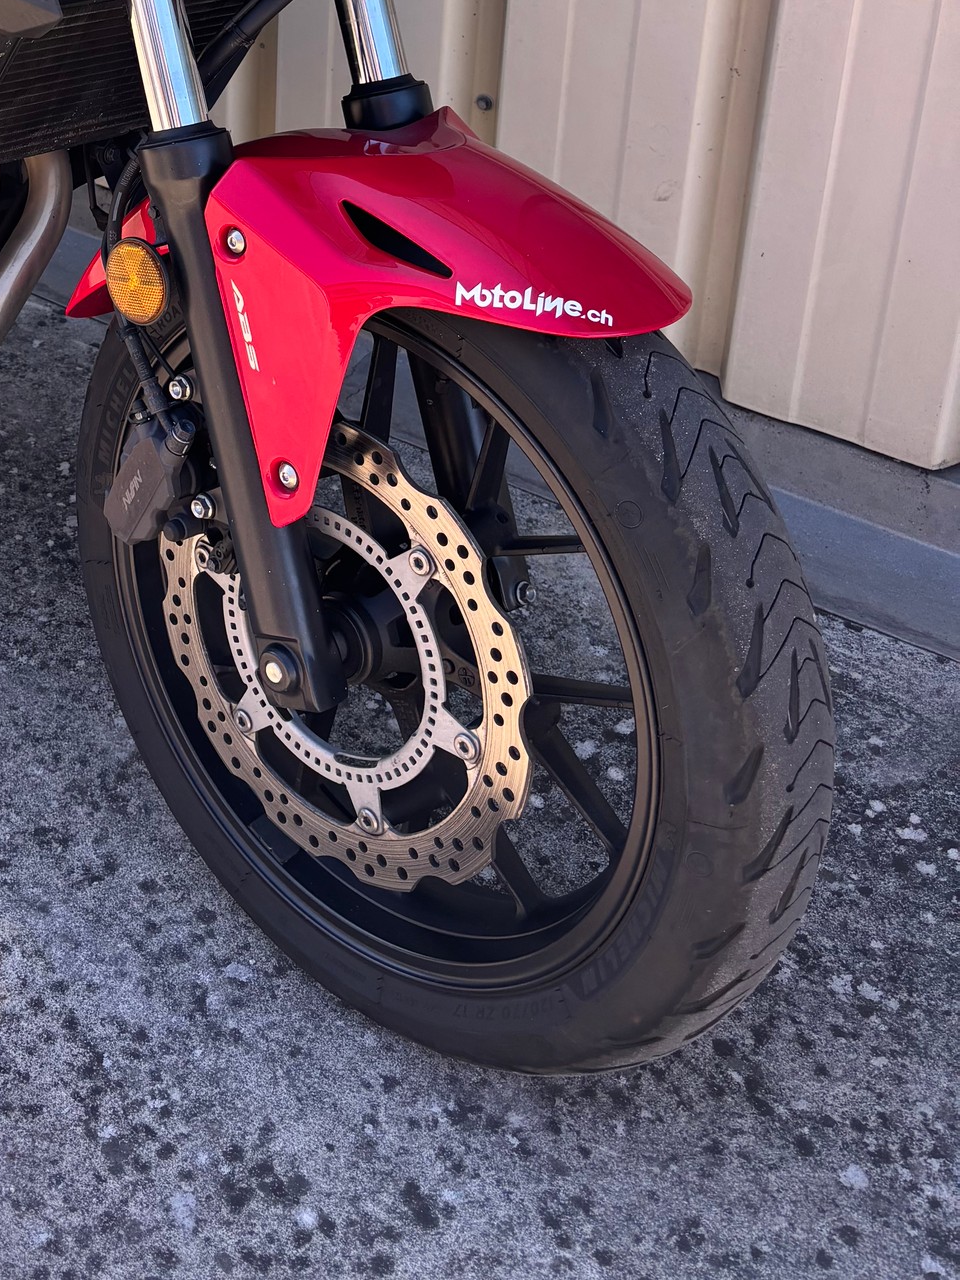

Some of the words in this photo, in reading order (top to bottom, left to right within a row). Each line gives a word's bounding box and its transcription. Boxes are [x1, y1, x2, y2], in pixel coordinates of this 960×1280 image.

[230, 279, 260, 372] ABS
[455, 281, 614, 327] MotoLine.ch
[97, 365, 137, 467] MICHEL
